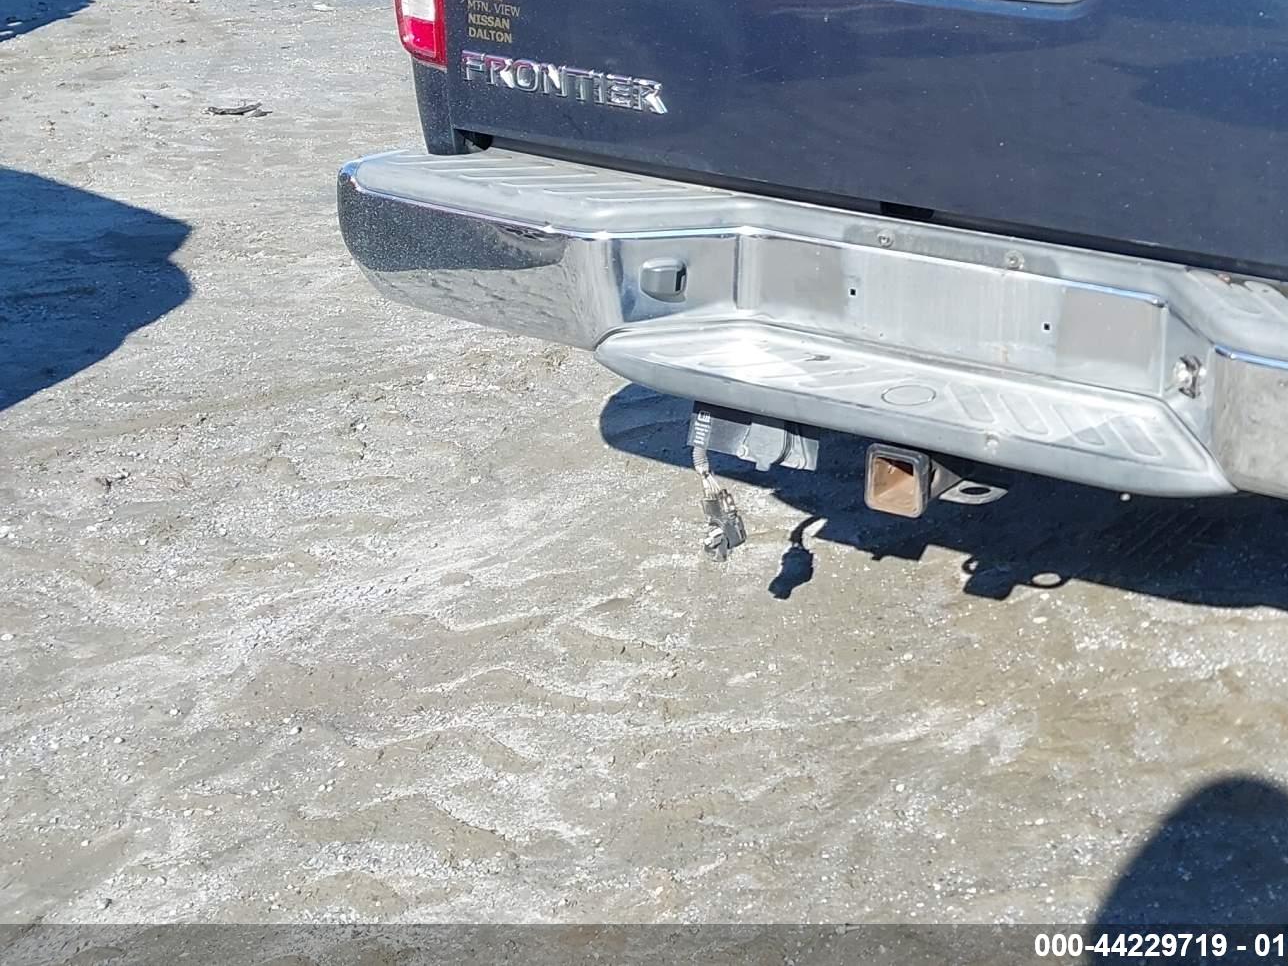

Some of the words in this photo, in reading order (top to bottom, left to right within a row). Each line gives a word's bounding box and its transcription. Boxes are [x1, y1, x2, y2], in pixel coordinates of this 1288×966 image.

[467, 0, 492, 13] MTN.
[493, 3, 521, 17] VIEW
[468, 13, 510, 29] NISSAN
[468, 26, 512, 43] DALTON
[462, 50, 668, 115] FRONTIER
